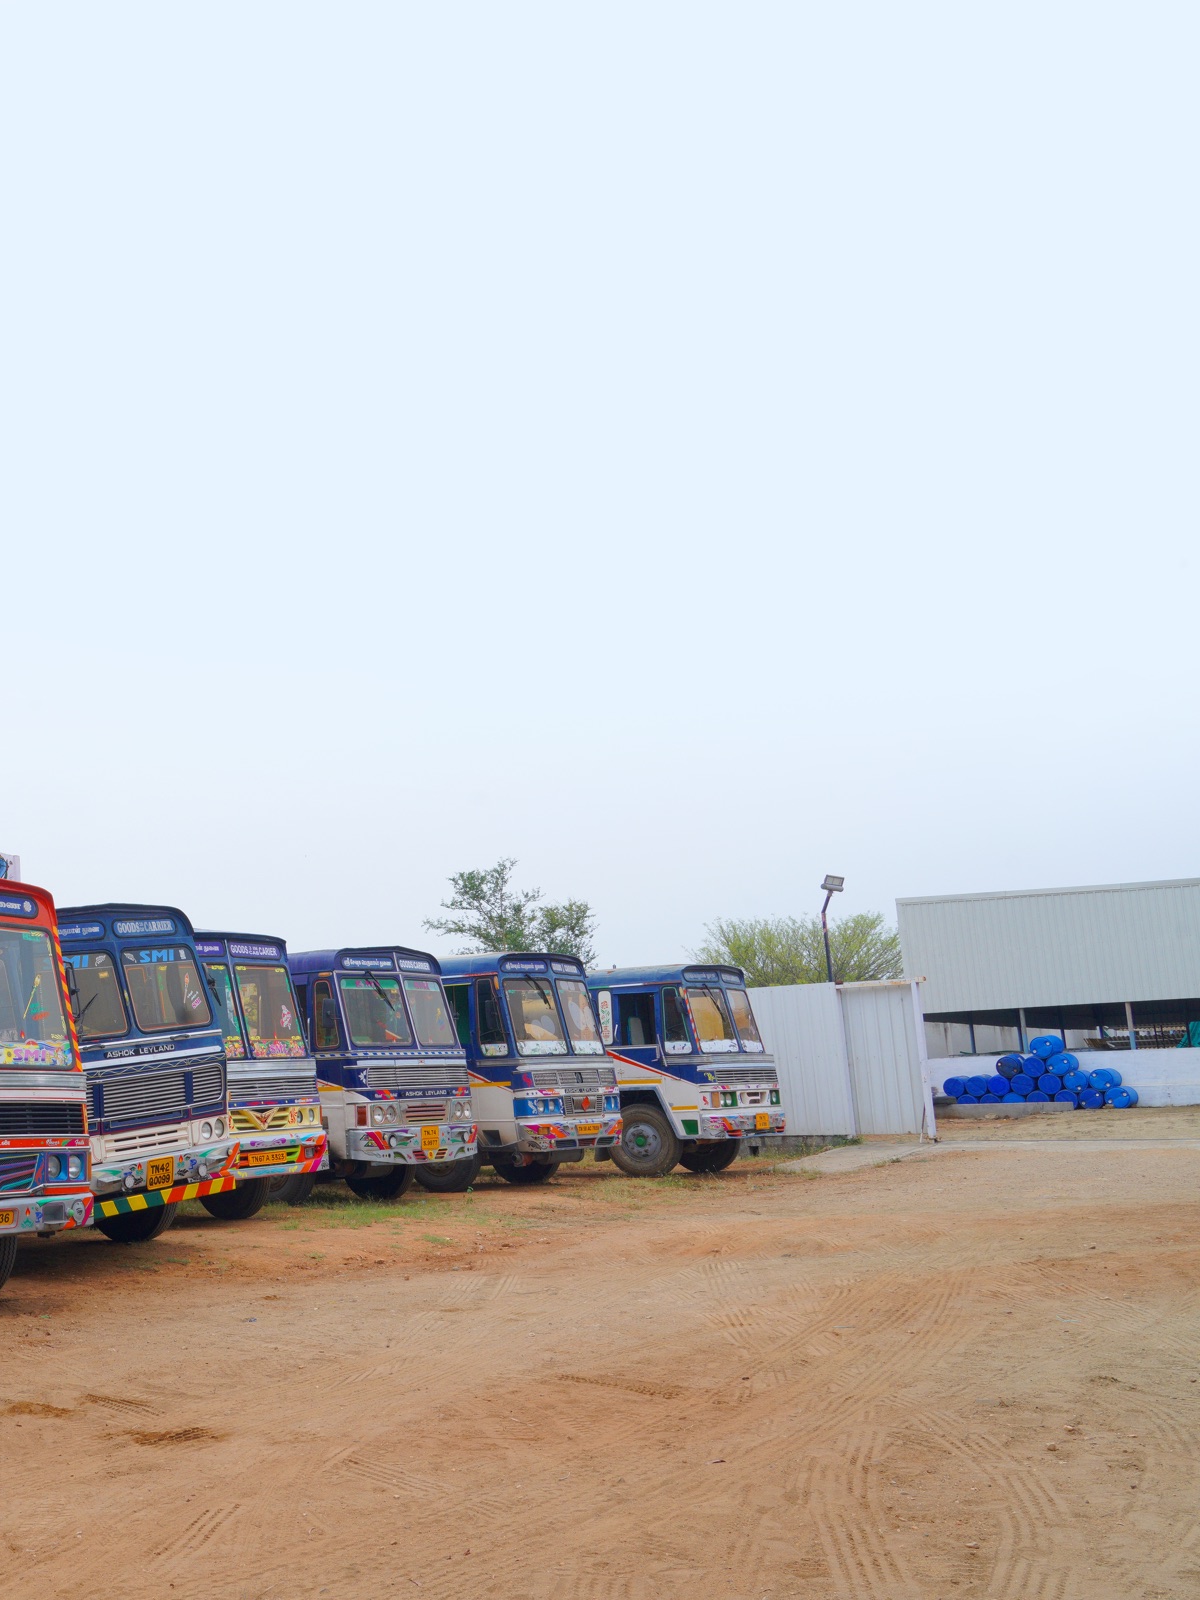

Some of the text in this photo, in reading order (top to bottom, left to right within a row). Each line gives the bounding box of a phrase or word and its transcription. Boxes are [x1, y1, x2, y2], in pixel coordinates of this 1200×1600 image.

[117, 921, 140, 934] GOODS
[139, 949, 175, 963] SMI
[230, 944, 249, 955] GOODS
[106, 1043, 175, 1059] ASHOK LEYLAND
